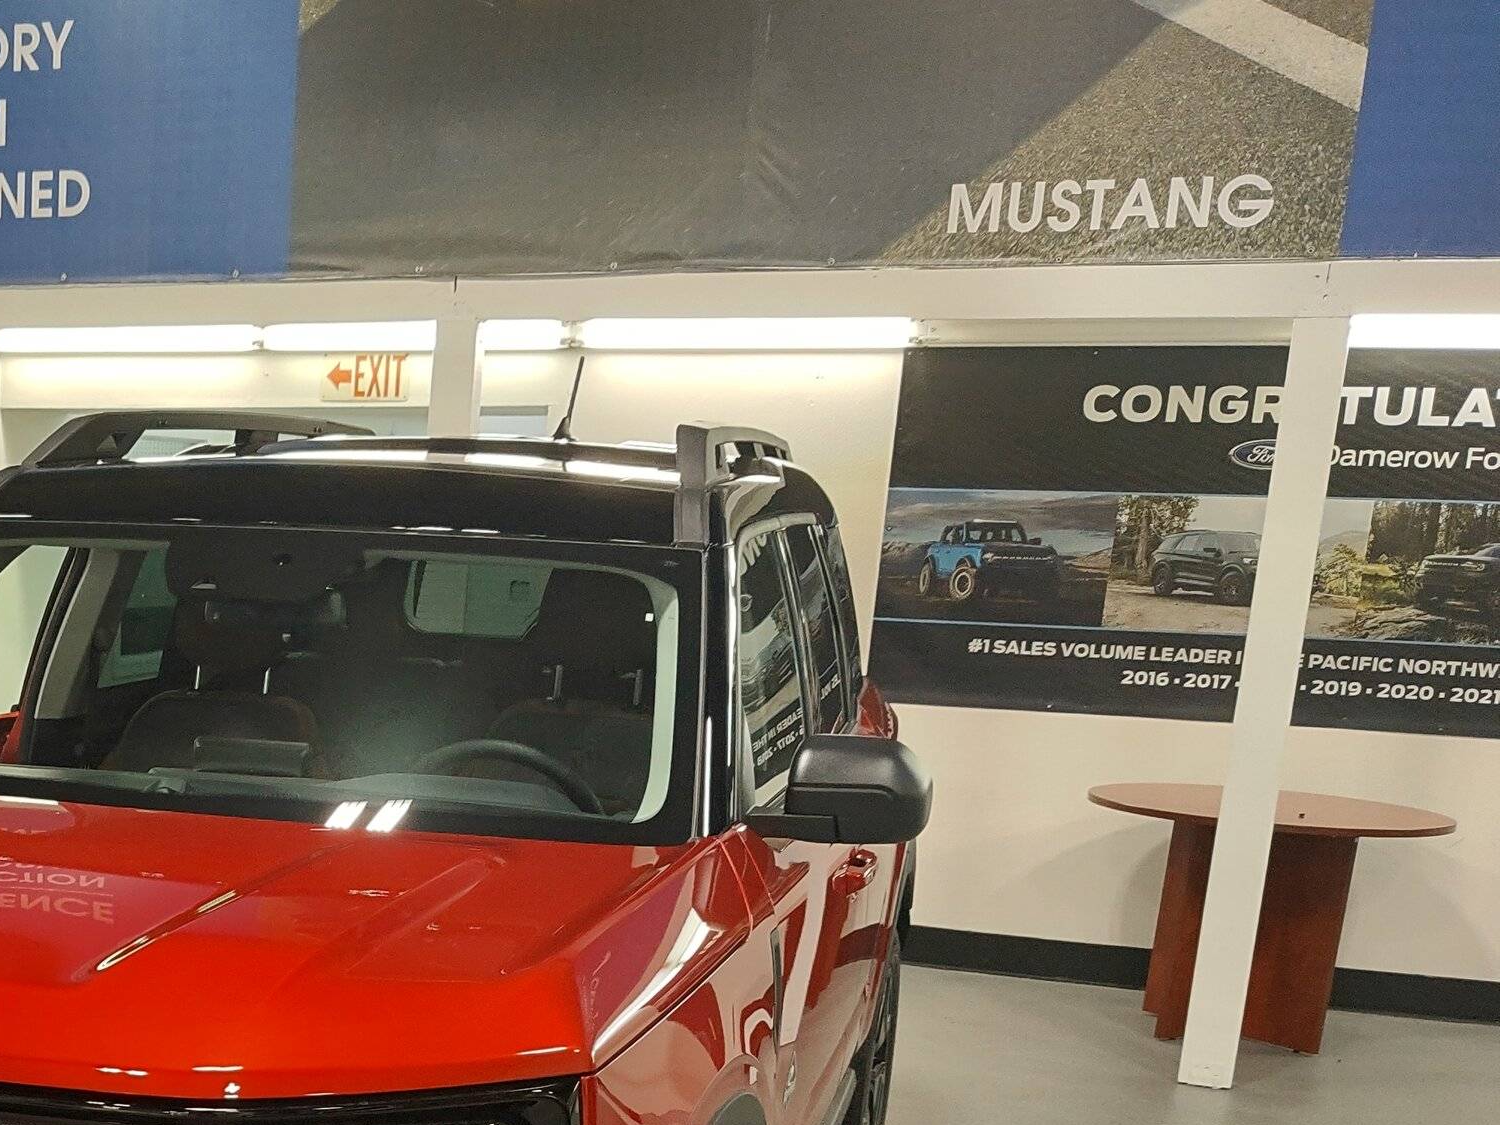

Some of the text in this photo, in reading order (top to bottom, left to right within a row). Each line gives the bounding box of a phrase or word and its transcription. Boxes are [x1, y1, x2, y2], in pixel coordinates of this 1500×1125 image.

[946, 174, 1275, 234] MUSTANG
[354, 353, 411, 398] EXIT
[1083, 384, 1500, 428] CONGRTULA
[967, 638, 990, 654] #1
[992, 638, 1057, 656] SALES
[1061, 642, 1146, 661] VOLUME
[1149, 646, 1230, 665] LEADER
[1308, 653, 1394, 673] PACIFIC
[1397, 658, 1500, 679] NORTHW
[1120, 670, 1500, 705] 2016 2017 2019 2020 2021
